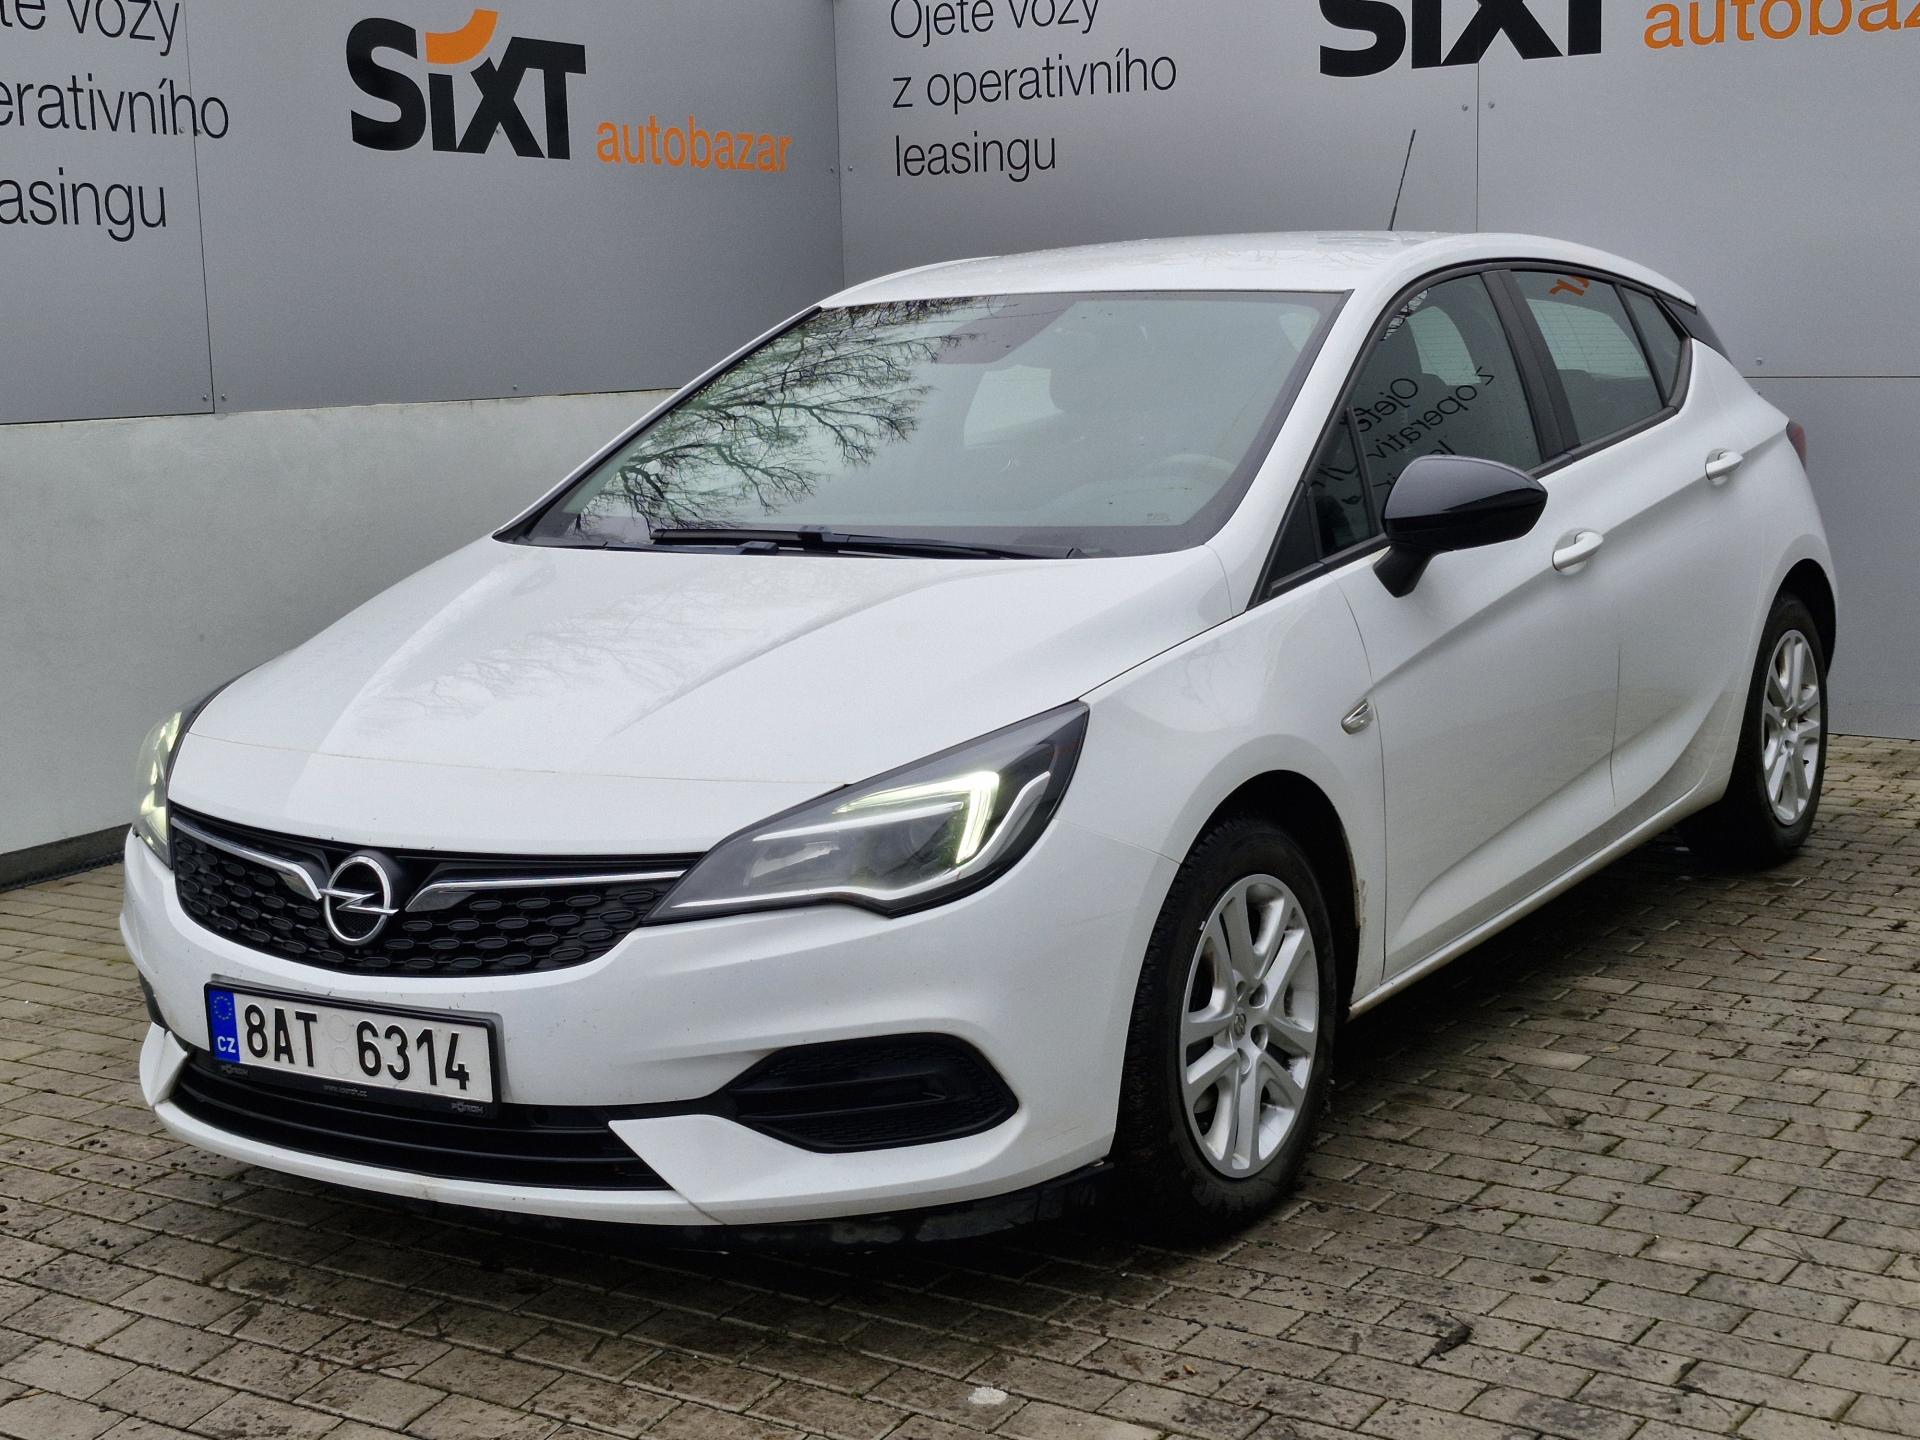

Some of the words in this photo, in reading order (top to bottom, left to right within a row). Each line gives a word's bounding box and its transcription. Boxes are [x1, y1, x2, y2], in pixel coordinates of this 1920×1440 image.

[67, 0, 180, 56] vozy
[1008, 0, 1099, 34] vozy
[892, 76, 914, 108] z
[926, 48, 1177, 115] operativního
[596, 114, 793, 172] autobazar
[895, 130, 1057, 182] leasingu
[0, 167, 167, 242] asingu
[217, 1035, 236, 1054] CZ
[244, 1003, 318, 1068] 8AT
[356, 1020, 470, 1090] 6314
